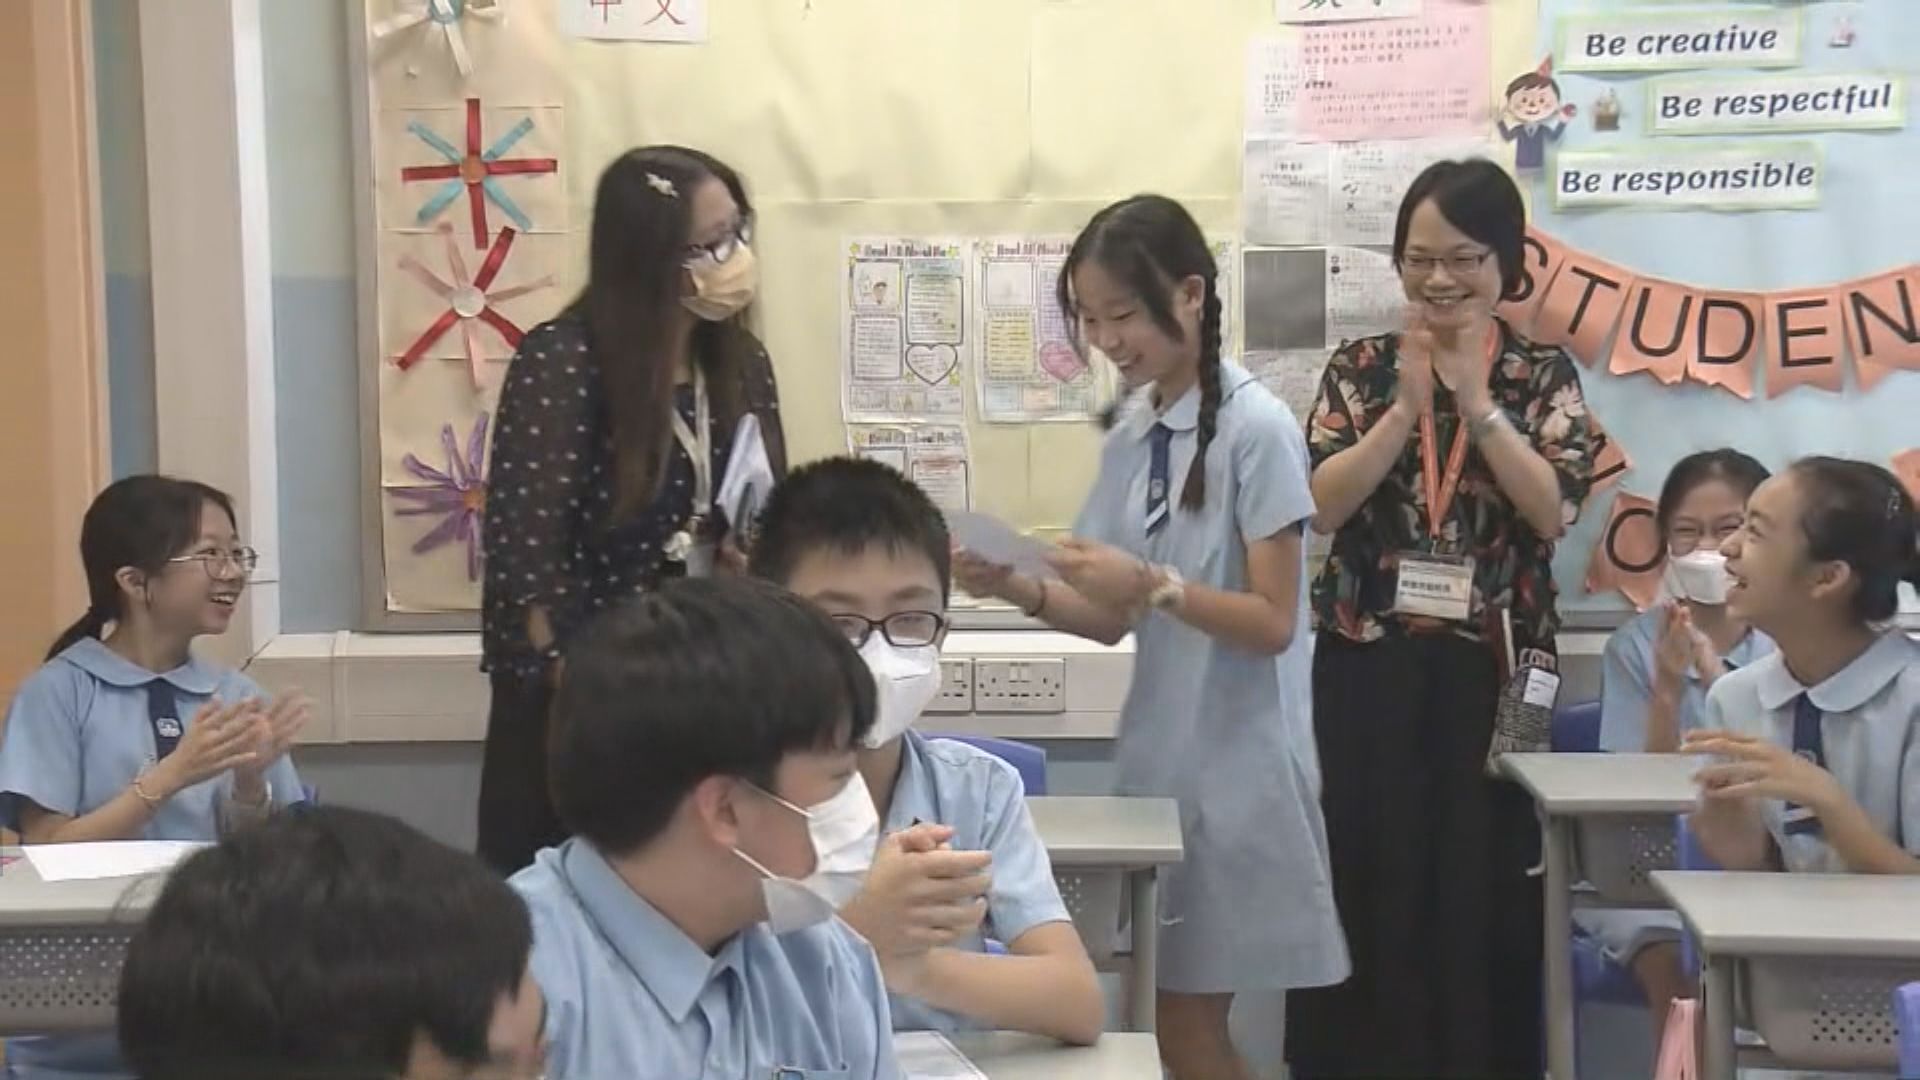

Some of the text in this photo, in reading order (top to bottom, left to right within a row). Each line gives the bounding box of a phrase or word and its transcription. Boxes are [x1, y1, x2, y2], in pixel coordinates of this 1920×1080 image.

[1586, 24, 1778, 57] Be creative
[1661, 83, 1892, 119] Be respectful
[1562, 162, 1815, 196] Be responsible
